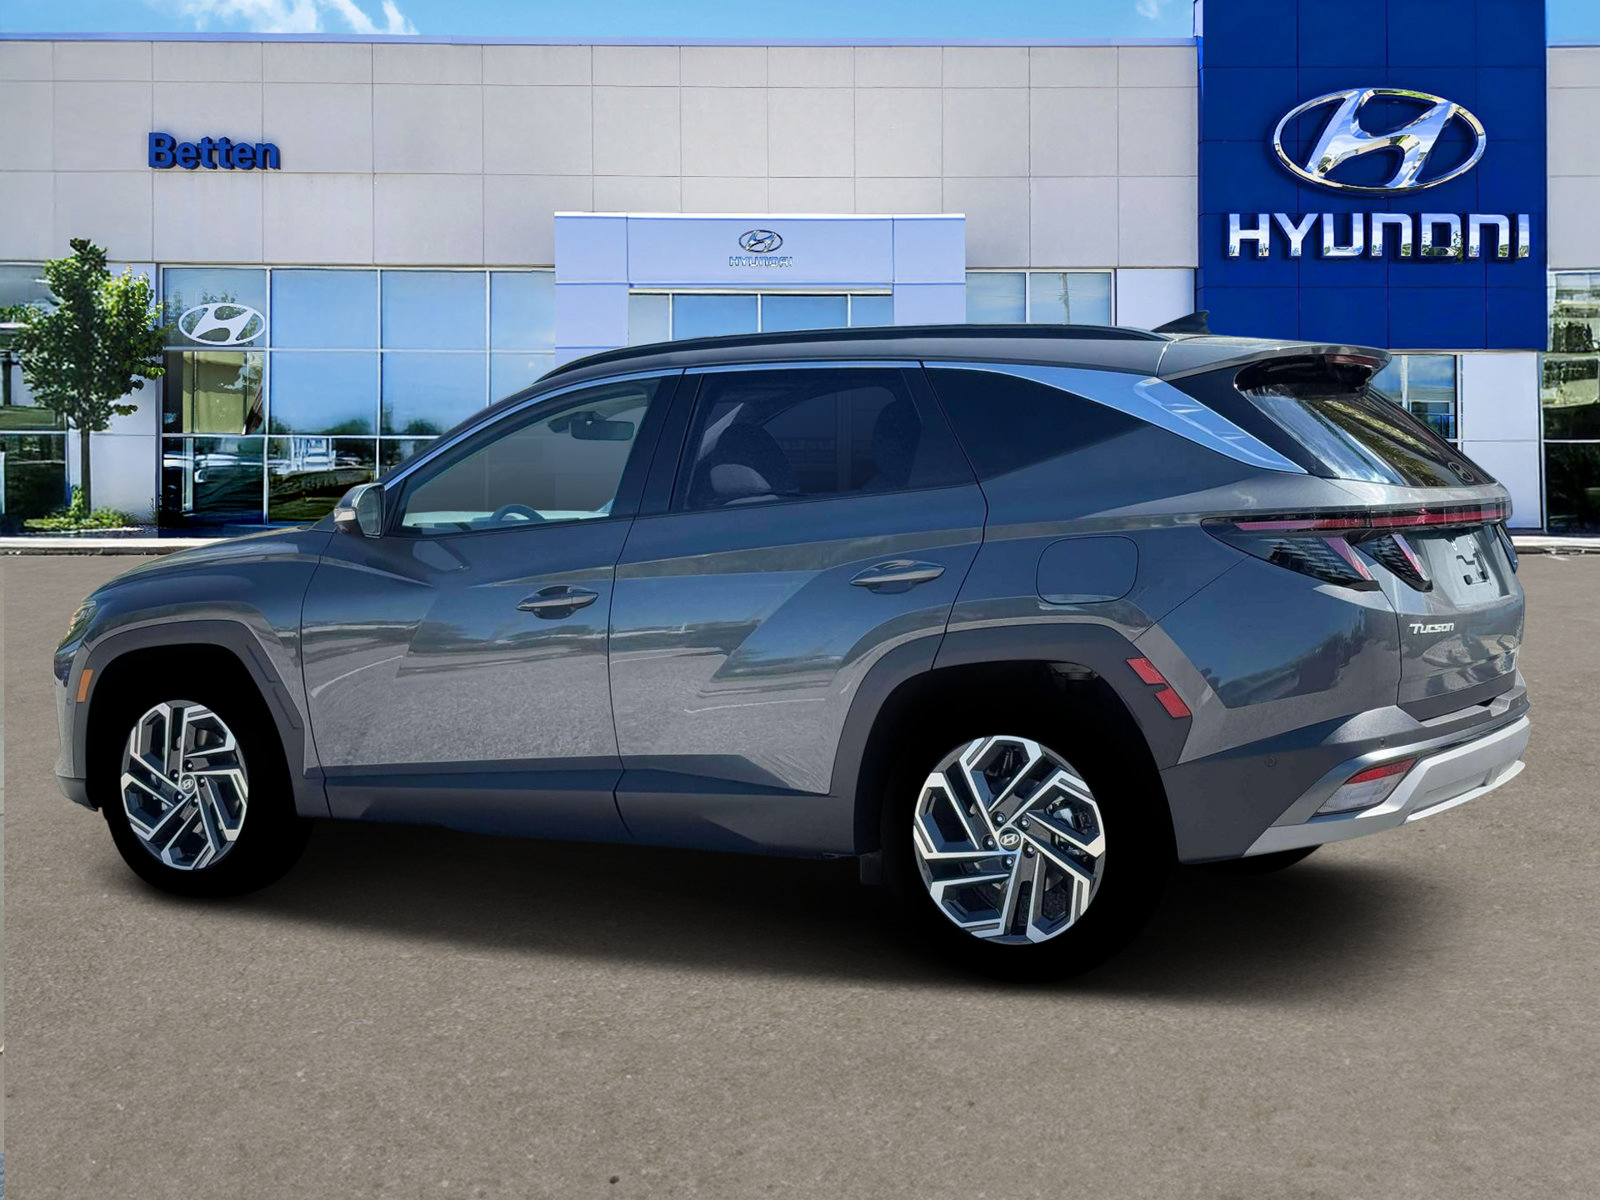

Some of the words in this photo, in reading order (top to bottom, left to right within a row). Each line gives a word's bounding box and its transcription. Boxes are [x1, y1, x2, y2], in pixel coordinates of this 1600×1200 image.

[148, 132, 281, 170] Betten
[1227, 212, 1530, 258] HYUNDAI
[729, 256, 793, 267] HYUNDAI
